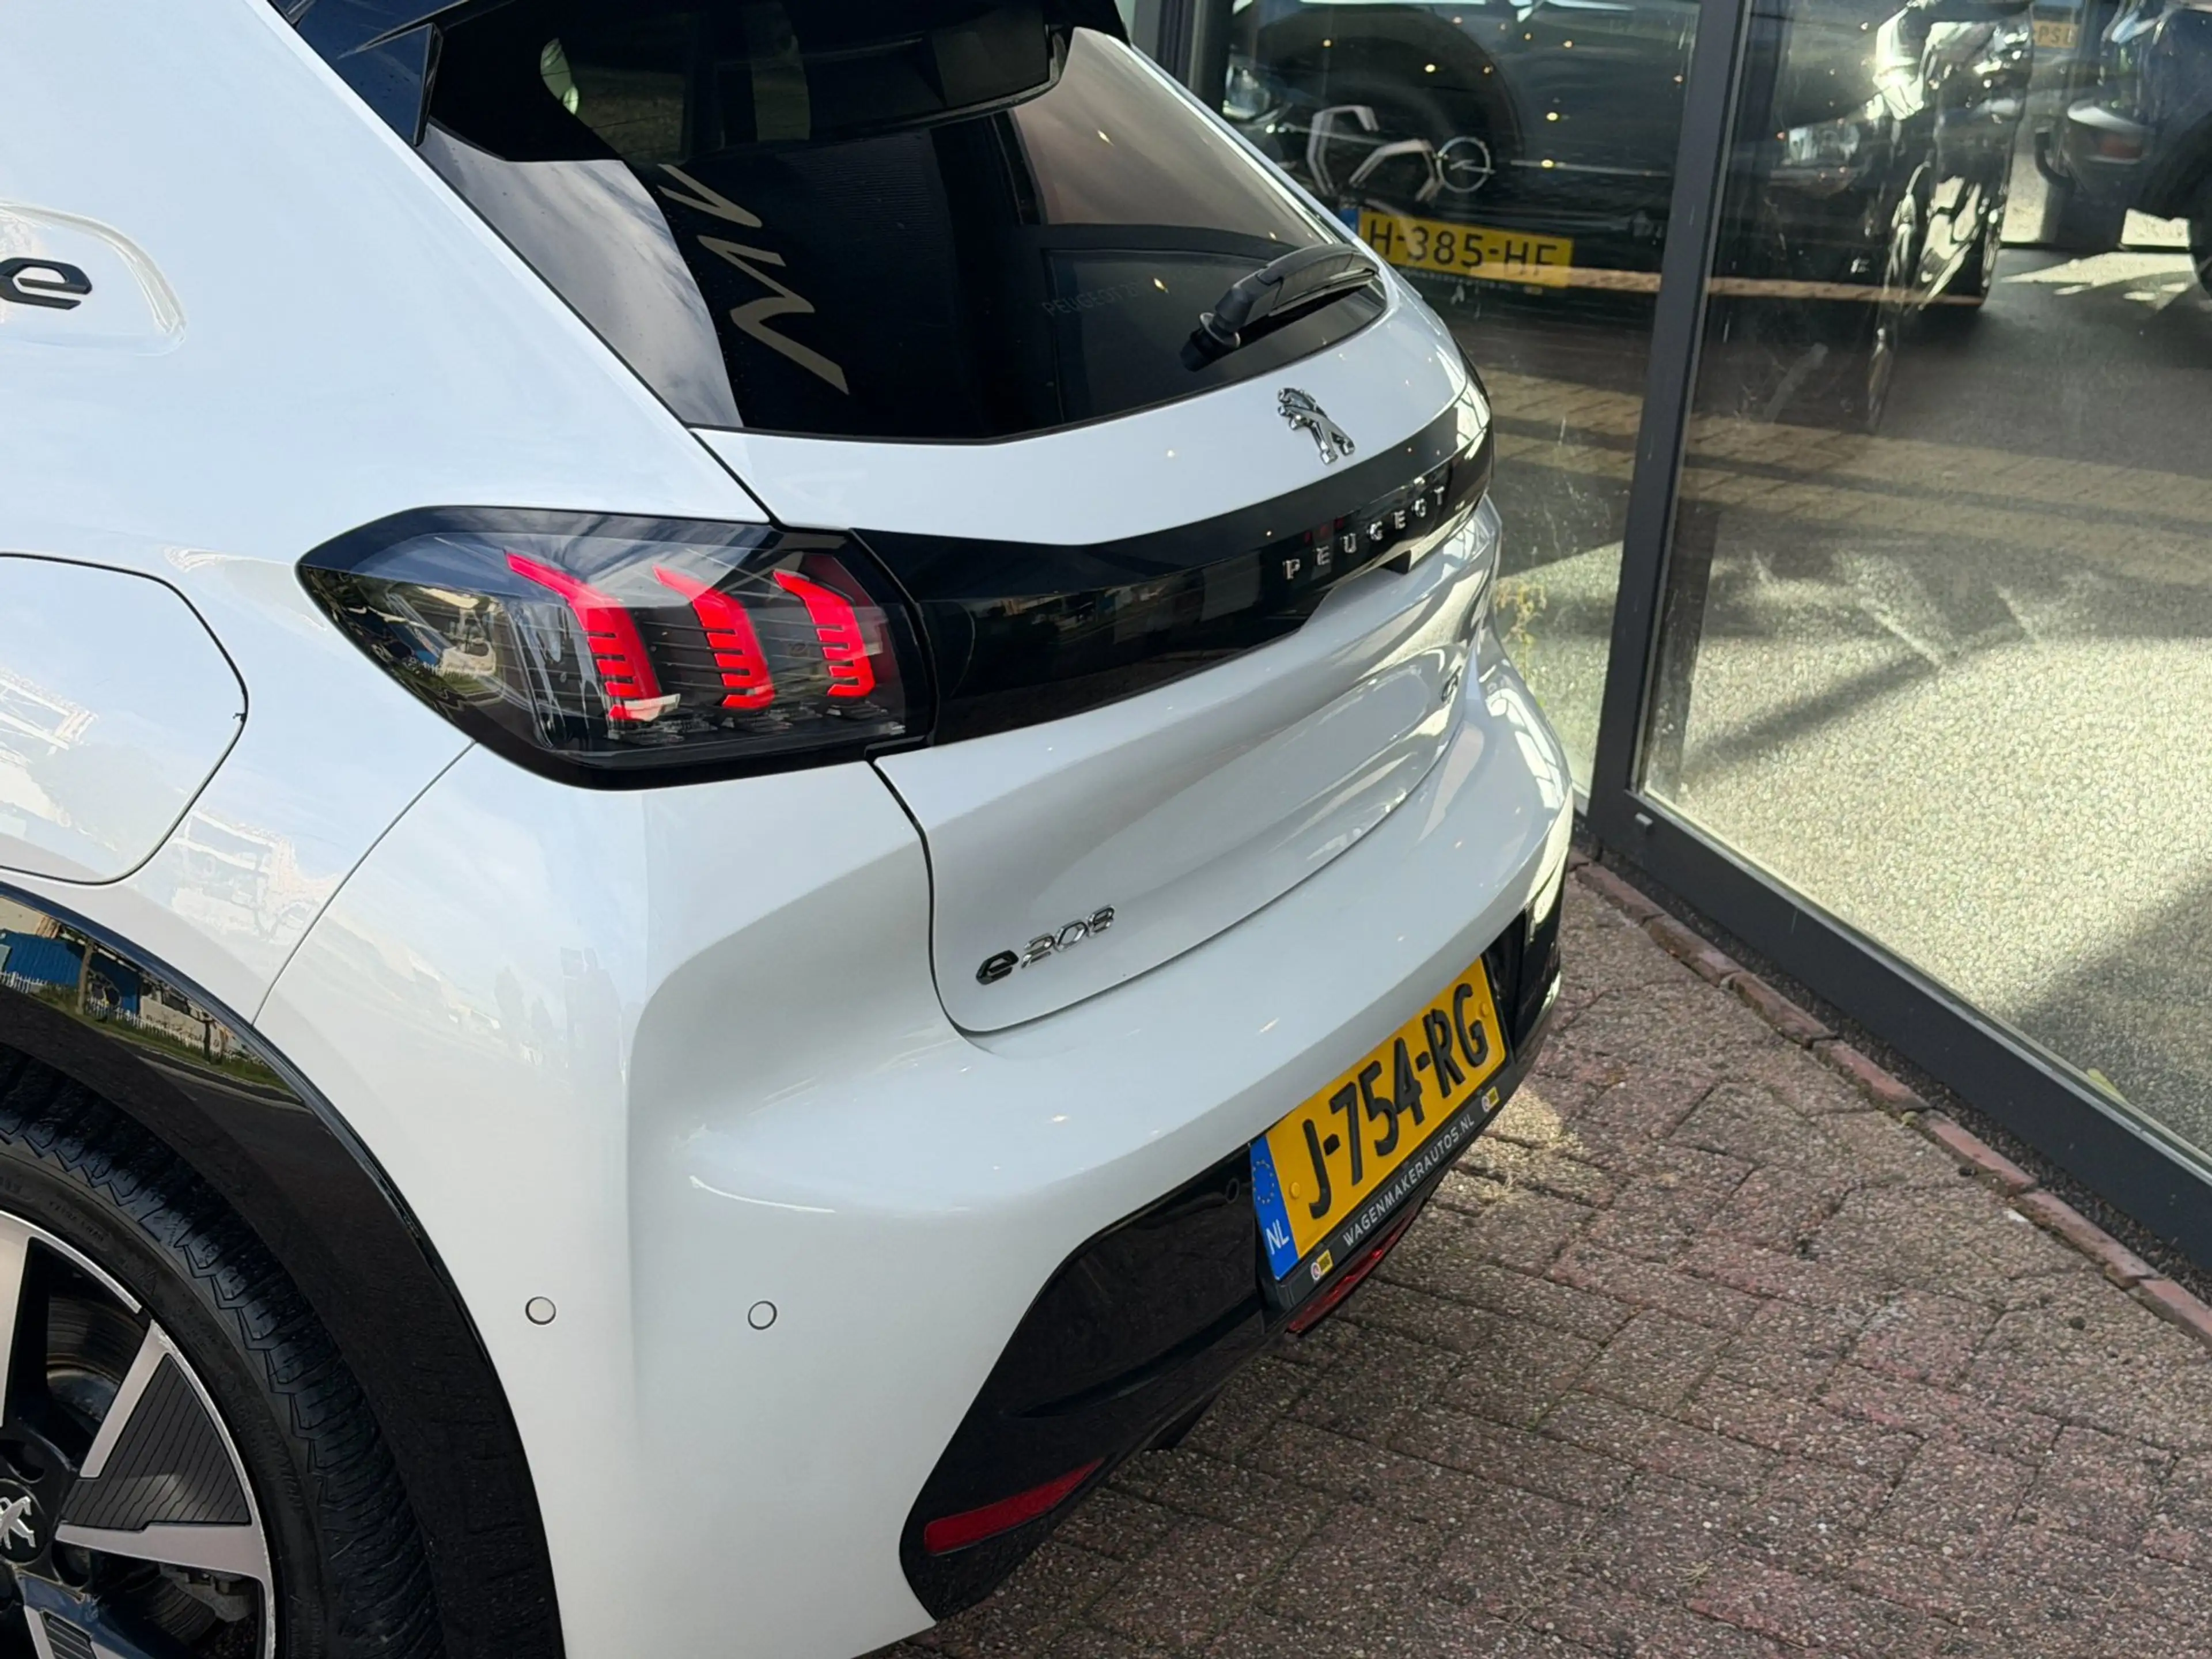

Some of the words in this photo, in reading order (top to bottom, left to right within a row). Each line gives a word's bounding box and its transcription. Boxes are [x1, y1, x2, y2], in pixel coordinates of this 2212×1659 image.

[0, 257, 93, 310] e
[1282, 486, 1445, 580] PEUGEOT
[1302, 983, 1489, 1221] J-754-RG
[1342, 1116, 1475, 1247] WAGENMAKERAUTOS.NL
[1266, 1218, 1290, 1255] NL
